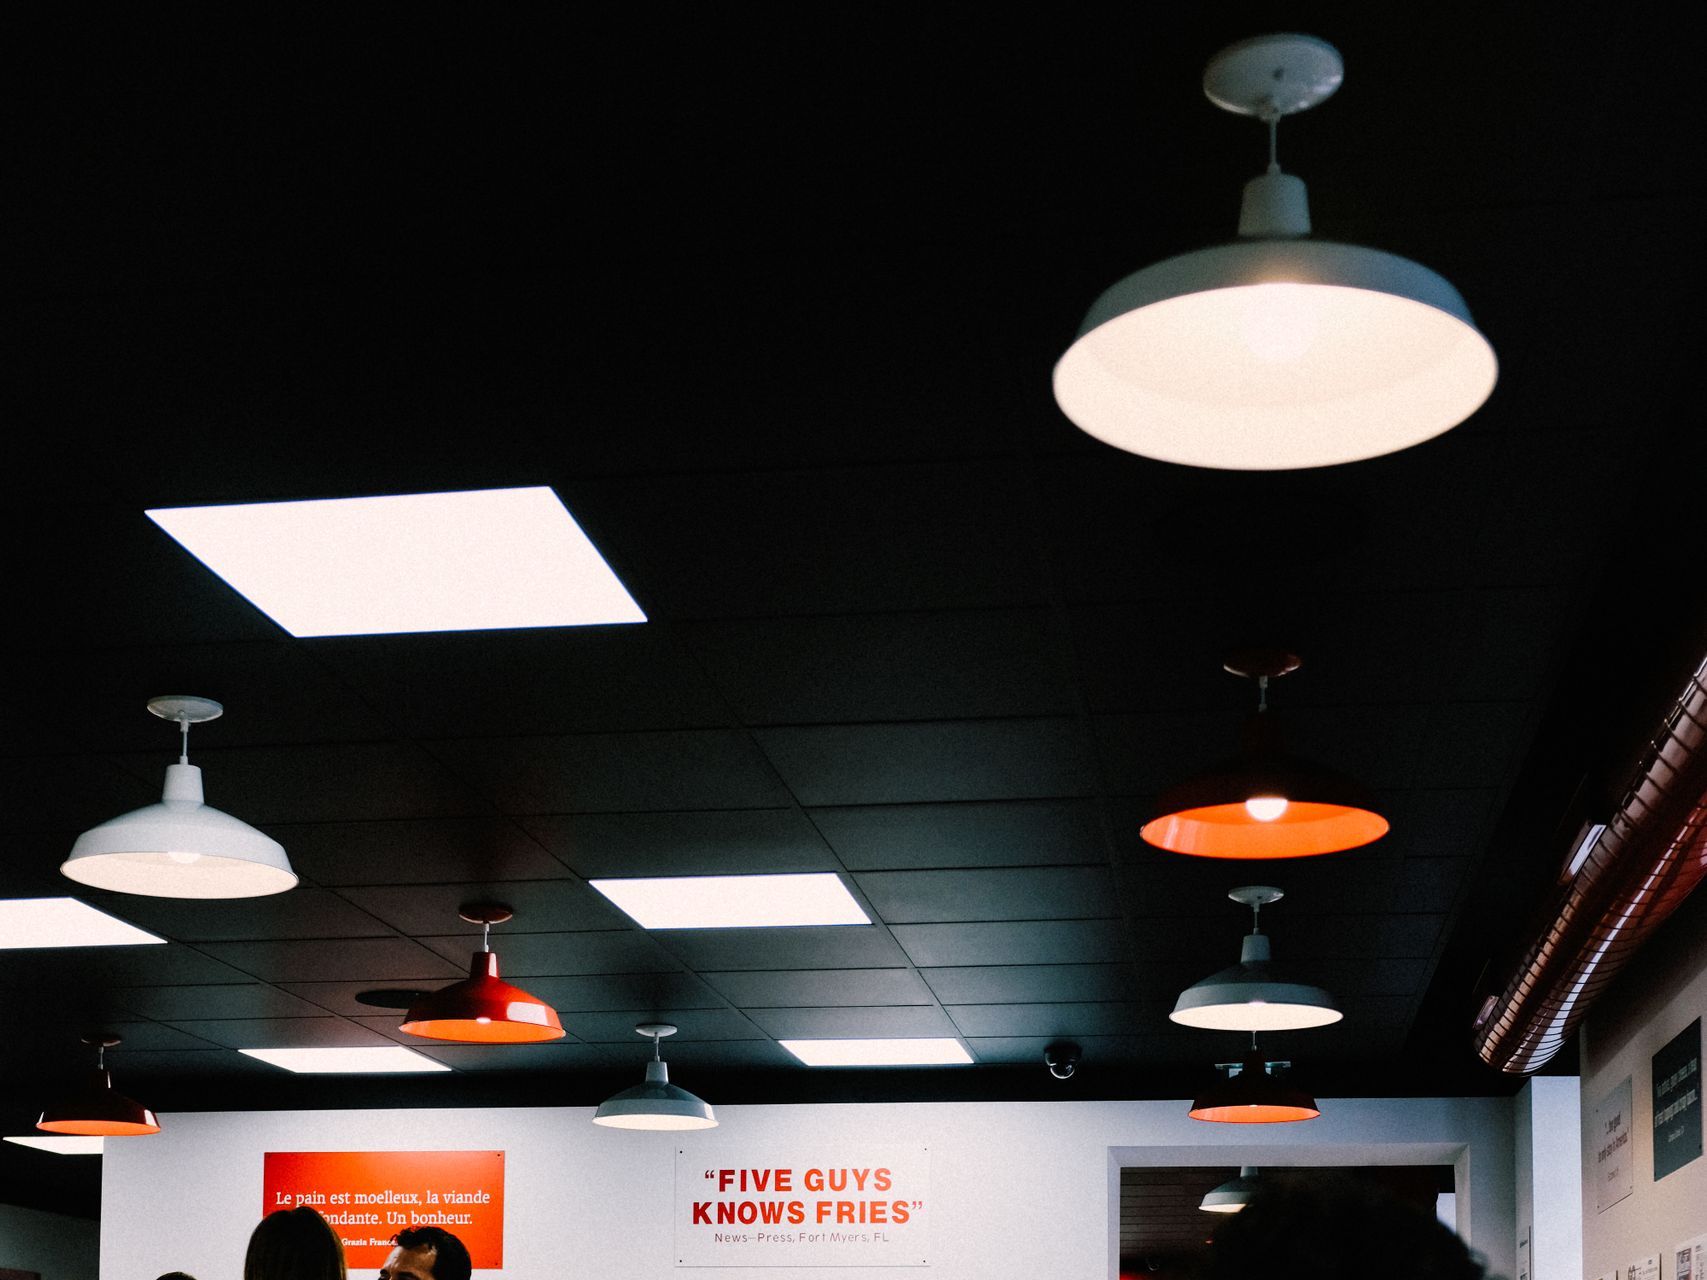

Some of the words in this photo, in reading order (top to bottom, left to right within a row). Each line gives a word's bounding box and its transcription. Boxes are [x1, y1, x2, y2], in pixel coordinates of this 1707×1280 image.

[704, 1168, 793, 1192] “FIVE
[804, 1168, 892, 1192] GUYS
[276, 1192, 292, 1205] Le
[295, 1190, 326, 1209] pain
[330, 1192, 351, 1205] est
[354, 1190, 422, 1206] moelleux,
[426, 1190, 440, 1204] la
[443, 1190, 490, 1204] viande
[318, 1210, 382, 1225] ondante.
[386, 1211, 407, 1225] Un
[410, 1210, 473, 1225] bonheur.
[692, 1200, 806, 1225] KNOWS
[816, 1200, 923, 1224] FRIES”
[341, 1237, 367, 1246] Grazia
[799, 1232, 826, 1242] Fort
[829, 1232, 870, 1244] Myers,
[873, 1232, 889, 1242] FL
